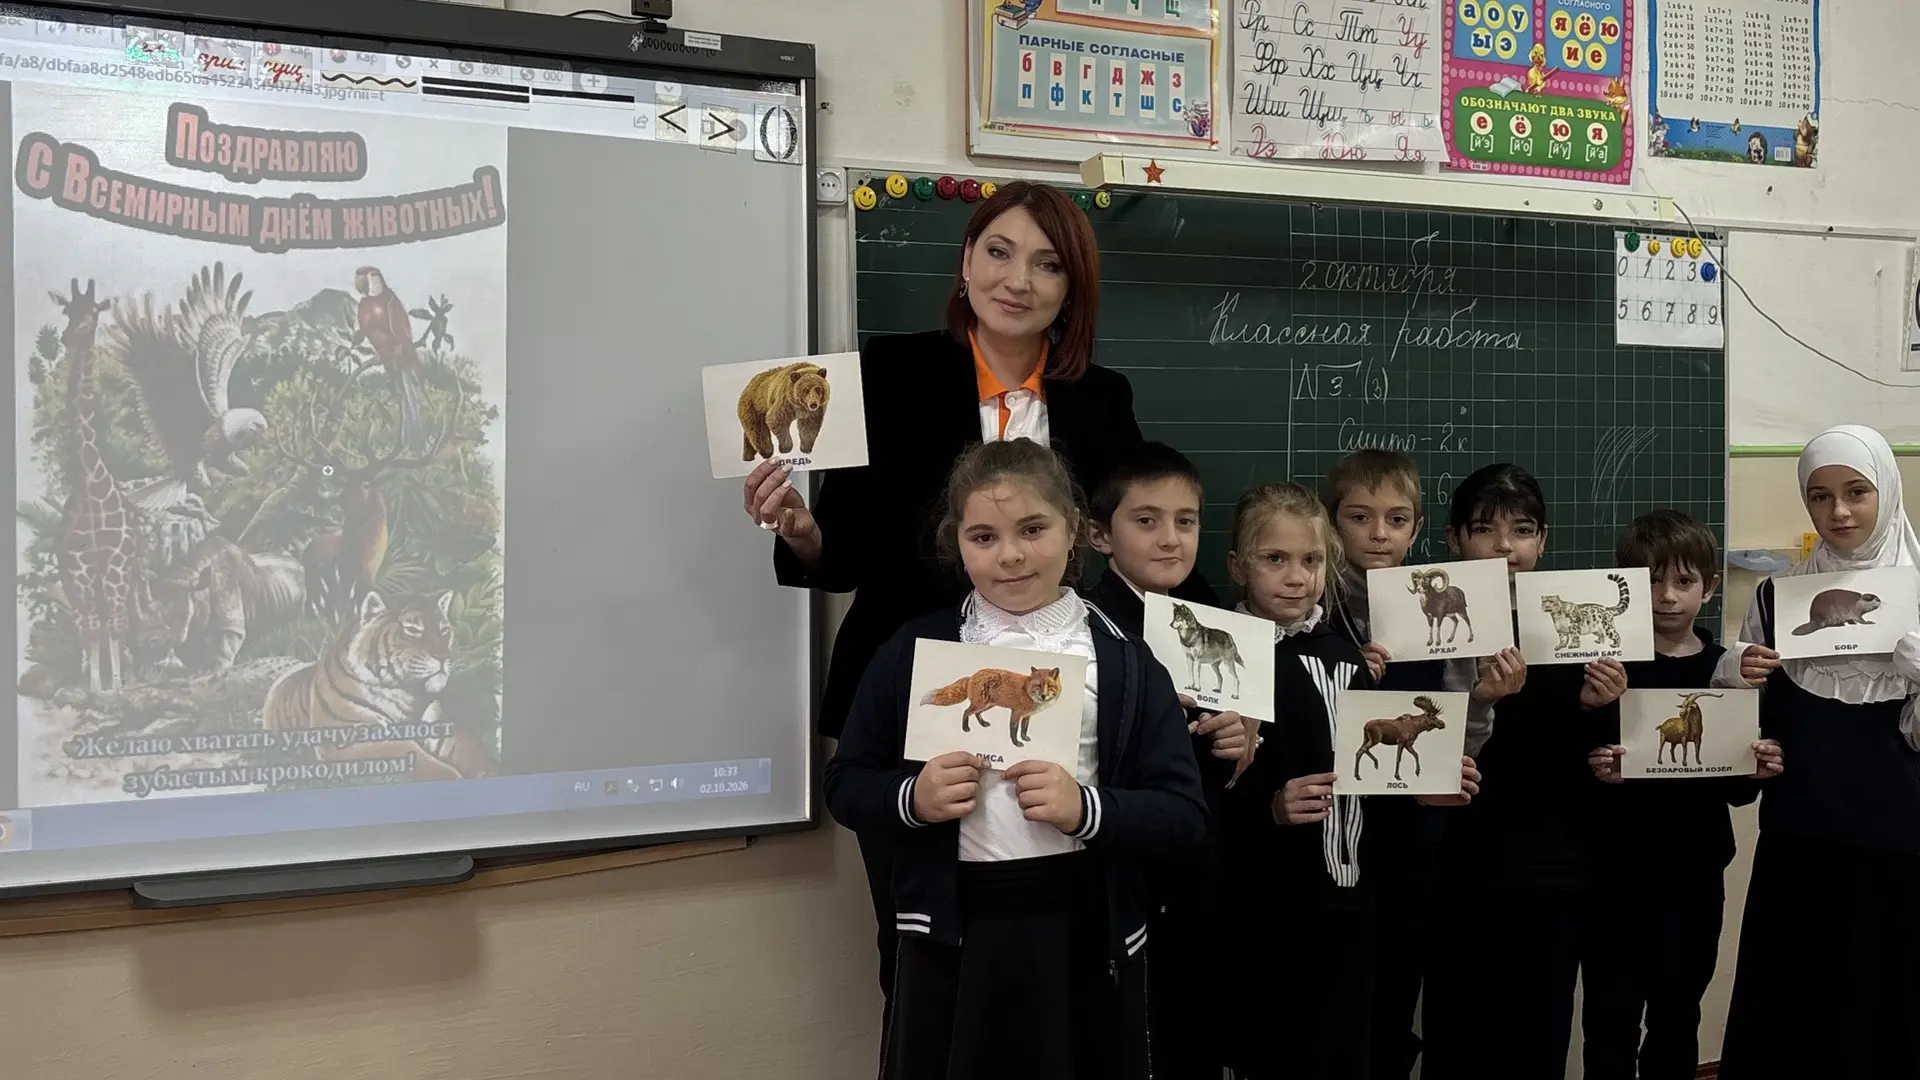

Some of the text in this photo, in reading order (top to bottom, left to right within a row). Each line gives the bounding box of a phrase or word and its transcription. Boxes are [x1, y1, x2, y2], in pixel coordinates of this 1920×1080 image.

[1463, 3, 1525, 30] а о у
[1555, 15, 1618, 37] я ё ю
[1019, 34, 1185, 63] ПАРНЫЕ СОГЛАСНЫЕ
[1472, 33, 1512, 52] ы э
[1566, 46, 1602, 64] и е
[1253, 41, 1422, 90] Фф Хх Цц Чч
[1461, 96, 1617, 122] ОБОЗНАЧАЮТ ДВА ЗВУКА
[1476, 115, 1603, 141] е ё ю я
[26, 140, 53, 190] С
[1617, 256, 1628, 276] 0
[1643, 258, 1652, 278] 1
[1665, 260, 1675, 280] 2
[1687, 261, 1697, 281] 3
[1209, 291, 1372, 345] Классная
[1617, 299, 1718, 325] 5 6 7 8 9
[777, 457, 812, 468] ДВЕДЬ
[1428, 646, 1458, 655] АРХАР
[1554, 649, 1623, 659] СНЕЖНЫЙ БАРС
[1834, 643, 1858, 651] БОБР
[1197, 694, 1220, 705] ВОЛК
[74, 719, 454, 760] Желаю хватать удачу за хвост
[123, 750, 415, 797] зубастым крокодилом!
[713, 766, 738, 778] 10:33
[1645, 765, 1732, 774] БЕЗОАРОВЫЙ КОЗЁЛ
[574, 781, 591, 793] RU
[700, 781, 749, 794] 02.10.2026
[1386, 782, 1409, 790] ЛОСЬ
